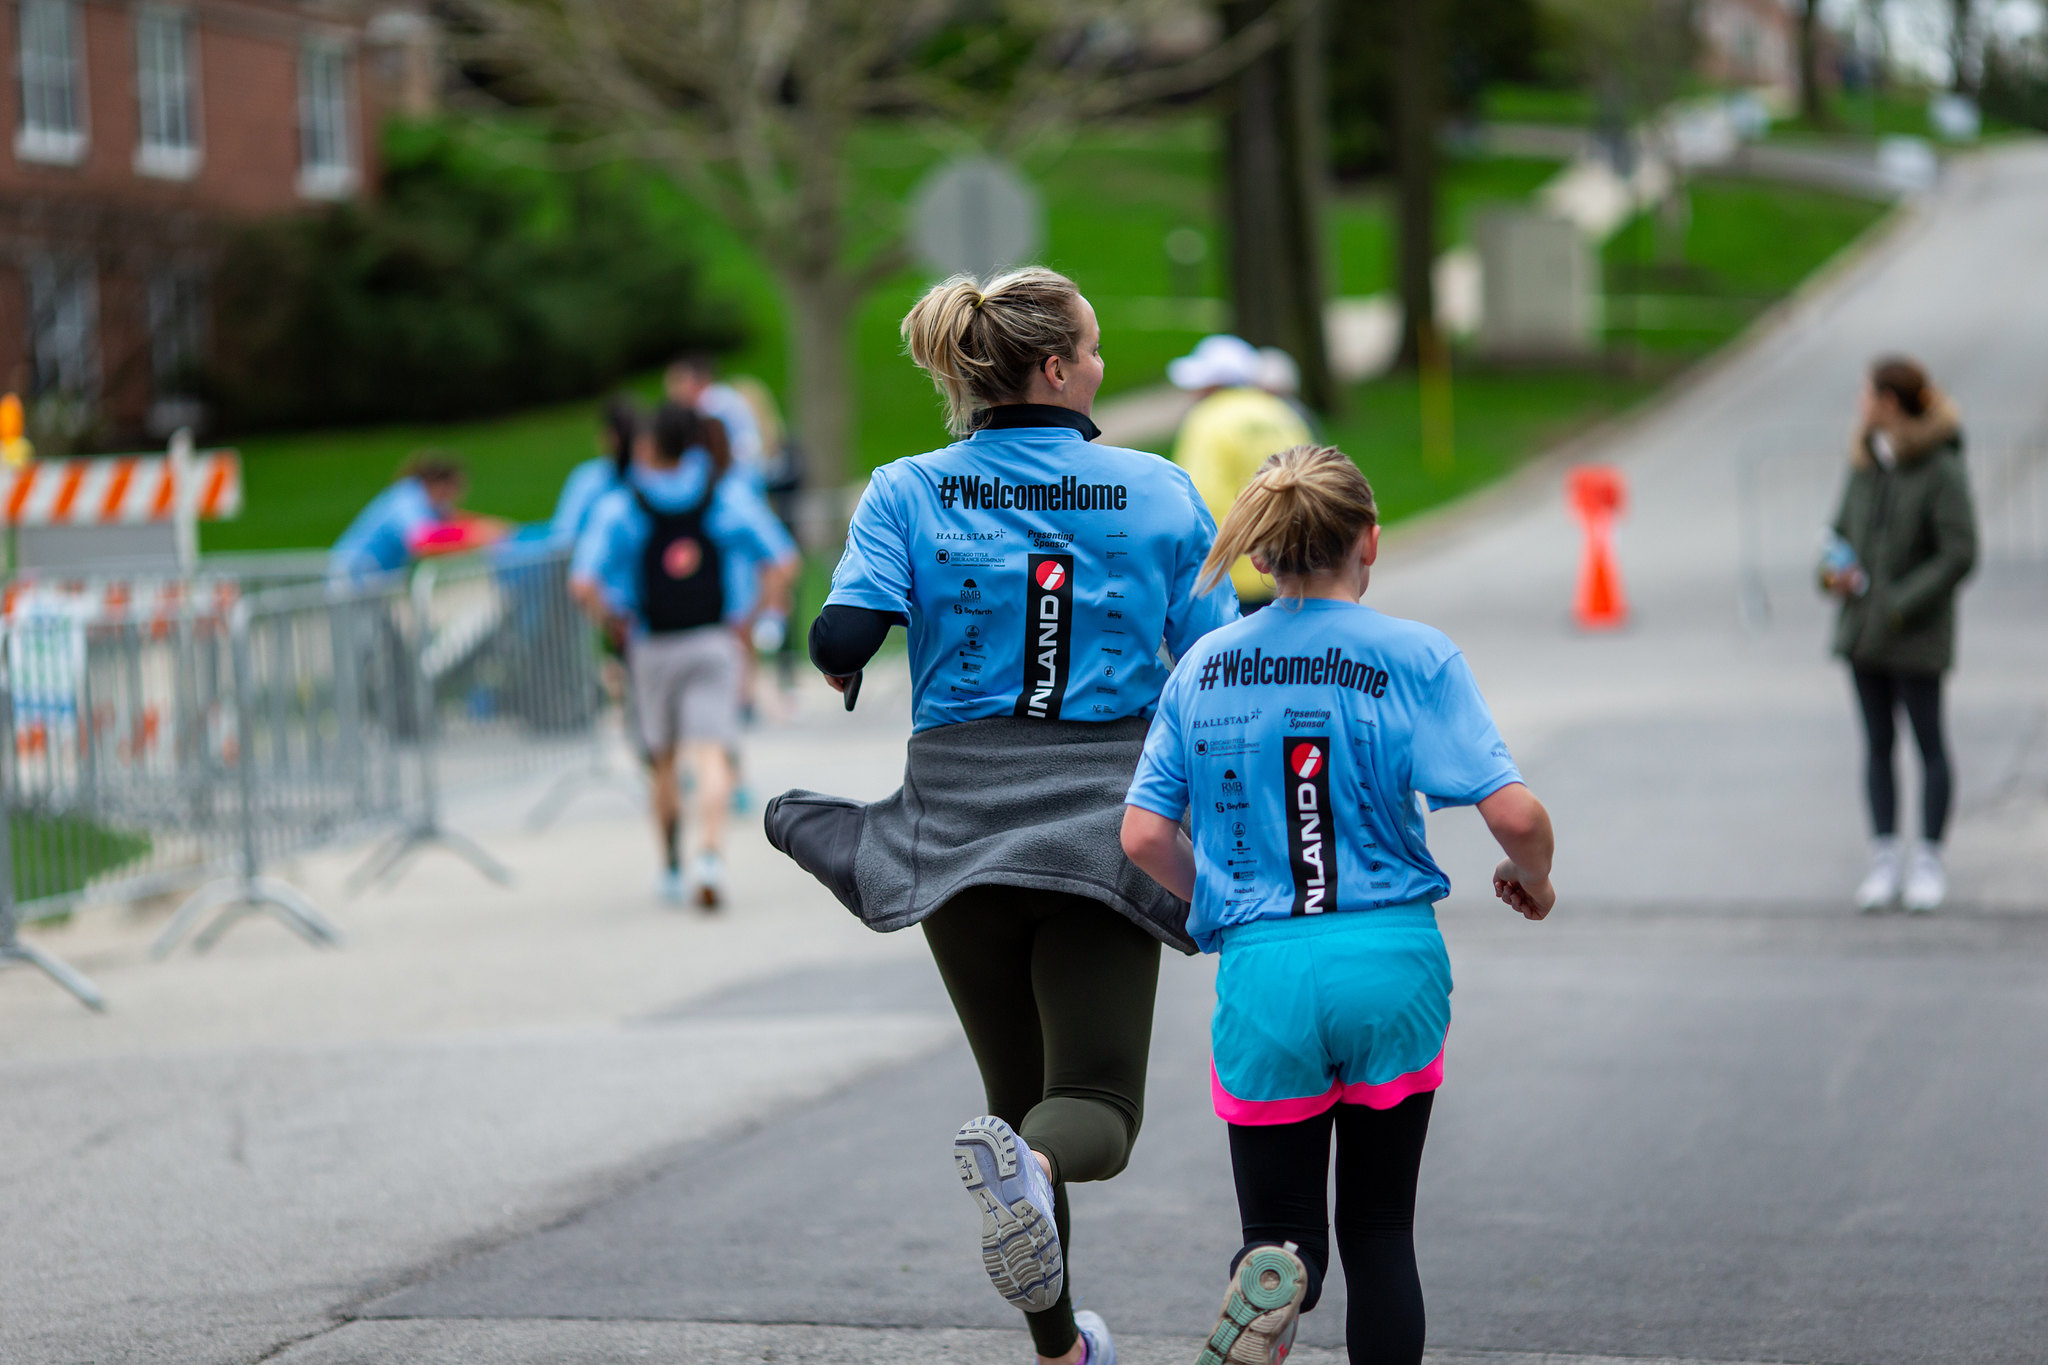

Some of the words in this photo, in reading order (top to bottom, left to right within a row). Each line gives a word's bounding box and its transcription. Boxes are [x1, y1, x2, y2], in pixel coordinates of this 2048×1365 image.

[938, 475, 1127, 511] #WelcomeHome
[936, 532, 994, 540] HALLSTAR
[1027, 529, 1074, 542] Presenting
[1033, 538, 1069, 549] Sponsor
[960, 590, 981, 599] RMB
[1027, 595, 1060, 718] INLAND
[1199, 648, 1389, 699] #WelcomeHome
[1284, 708, 1331, 720] Presenting
[1193, 716, 1250, 729] HALLSTAR
[1289, 718, 1326, 731] Sponsor
[1221, 782, 1242, 792] RMB
[1297, 782, 1326, 914] NLAND
